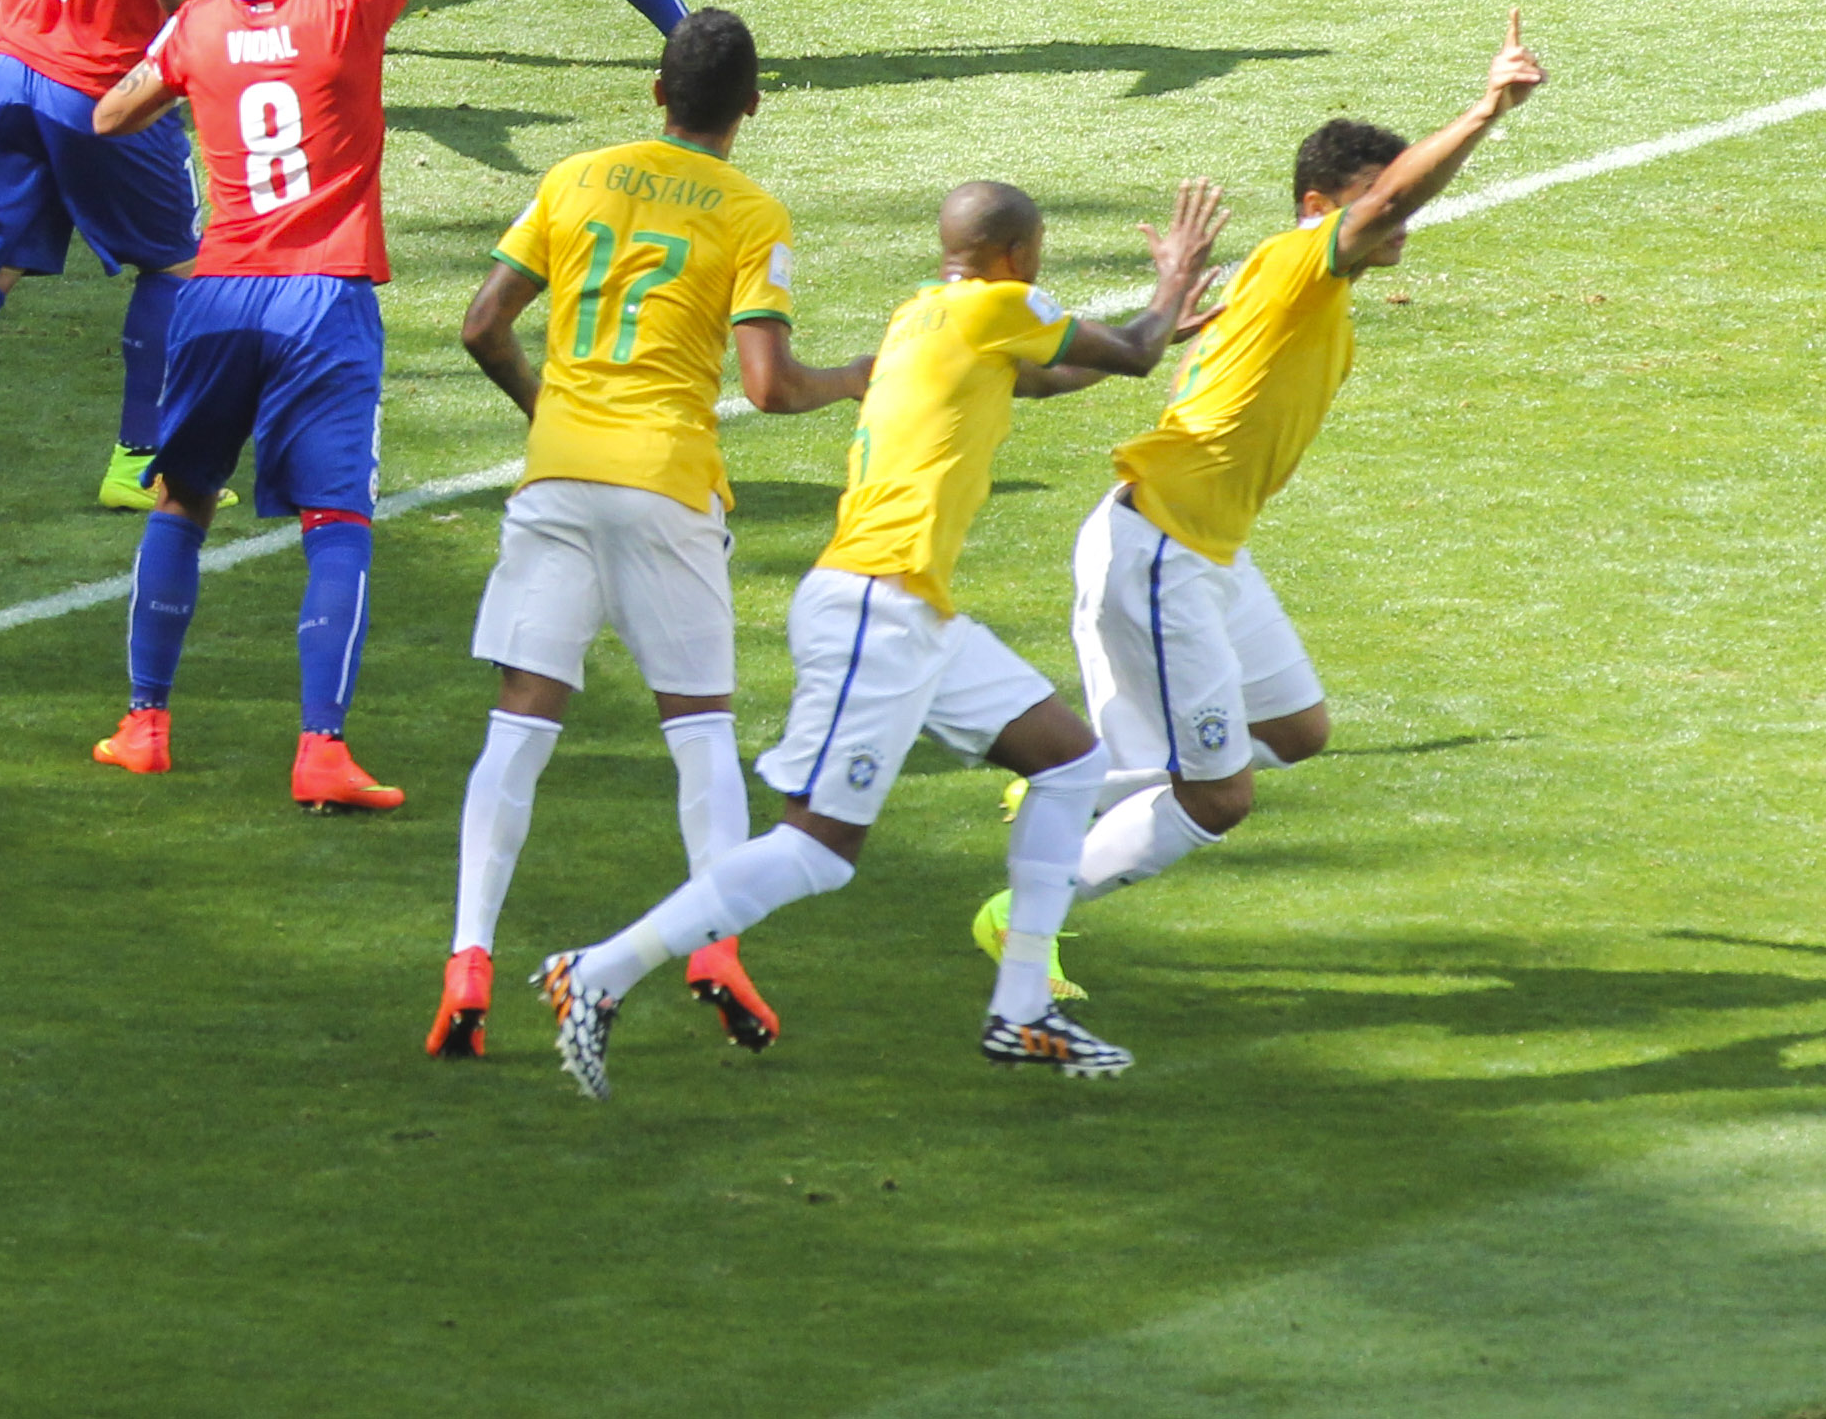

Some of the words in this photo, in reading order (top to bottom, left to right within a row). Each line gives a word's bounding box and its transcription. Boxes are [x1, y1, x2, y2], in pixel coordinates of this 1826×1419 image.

[227, 25, 299, 64] VIDAL
[239, 81, 311, 215] 8
[605, 163, 723, 212] GUSTAVO
[573, 220, 690, 364] 17
